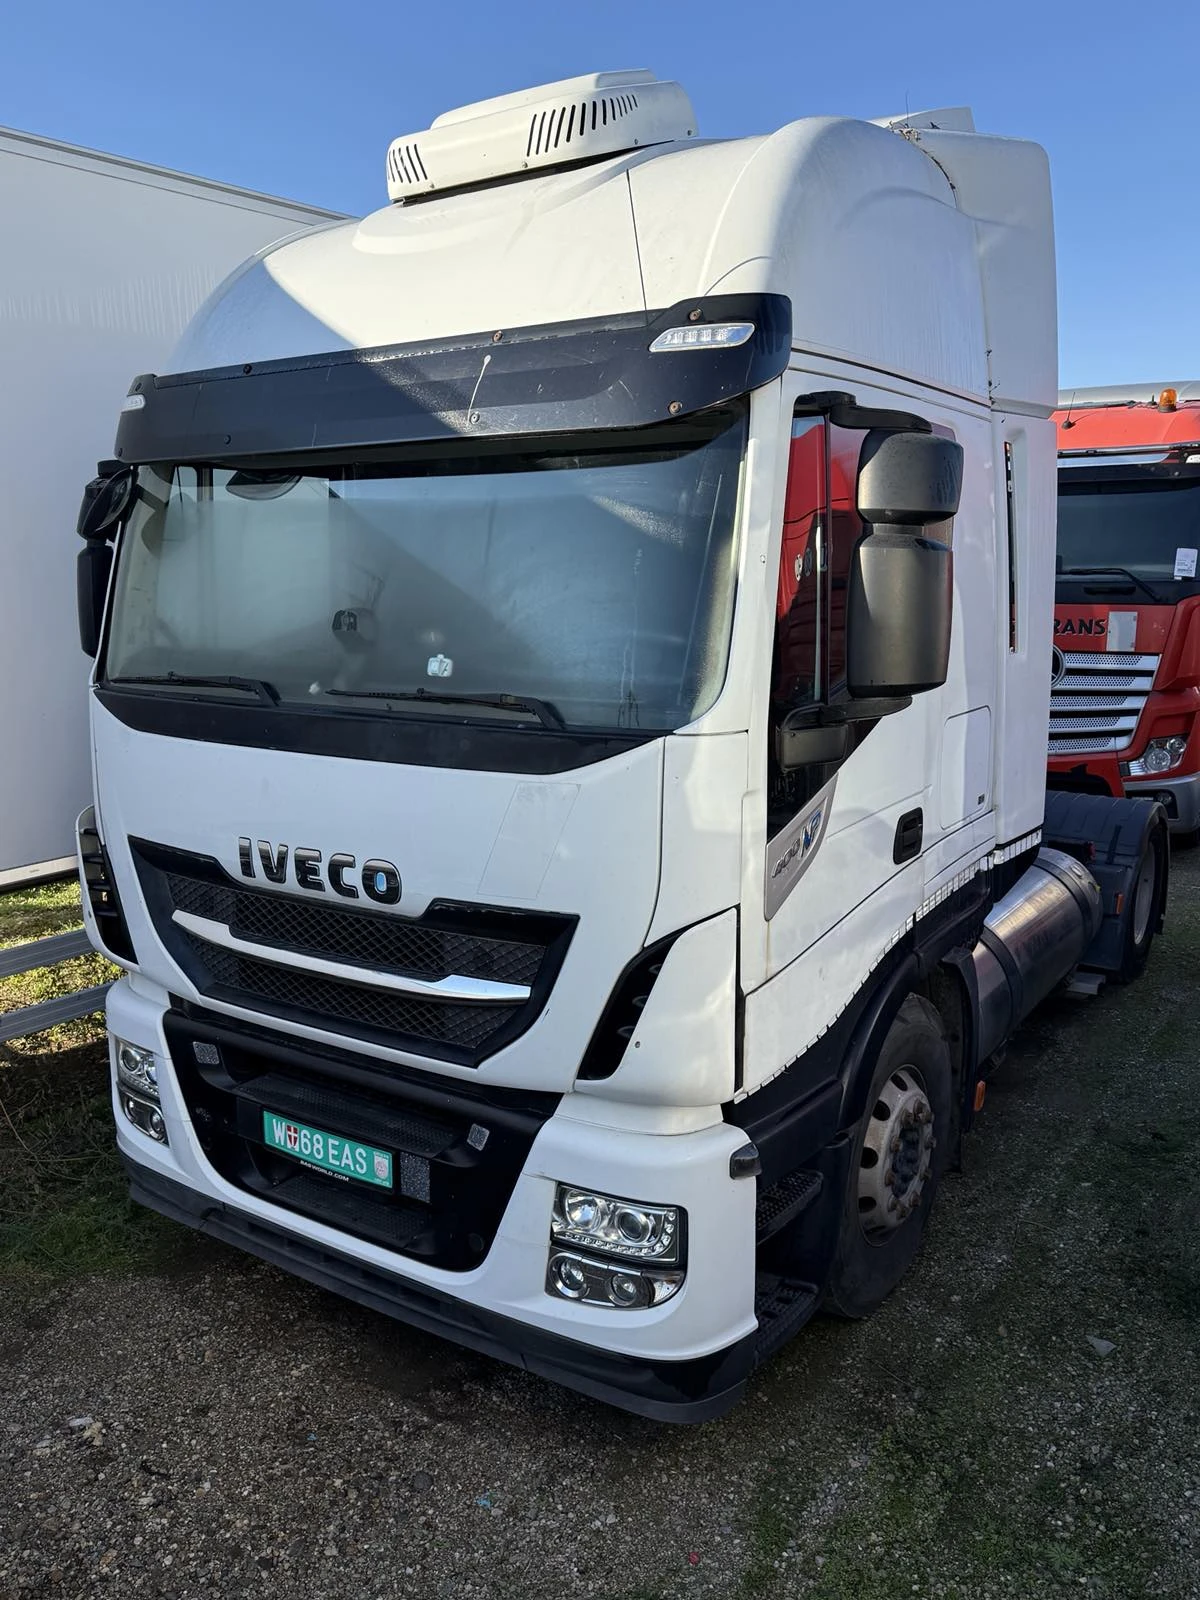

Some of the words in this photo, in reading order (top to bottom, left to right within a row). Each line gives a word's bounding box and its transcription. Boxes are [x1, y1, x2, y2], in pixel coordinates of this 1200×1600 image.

[238, 836, 403, 905] IVECO
[272, 1118, 285, 1146] W
[328, 1138, 367, 1174] EAS
